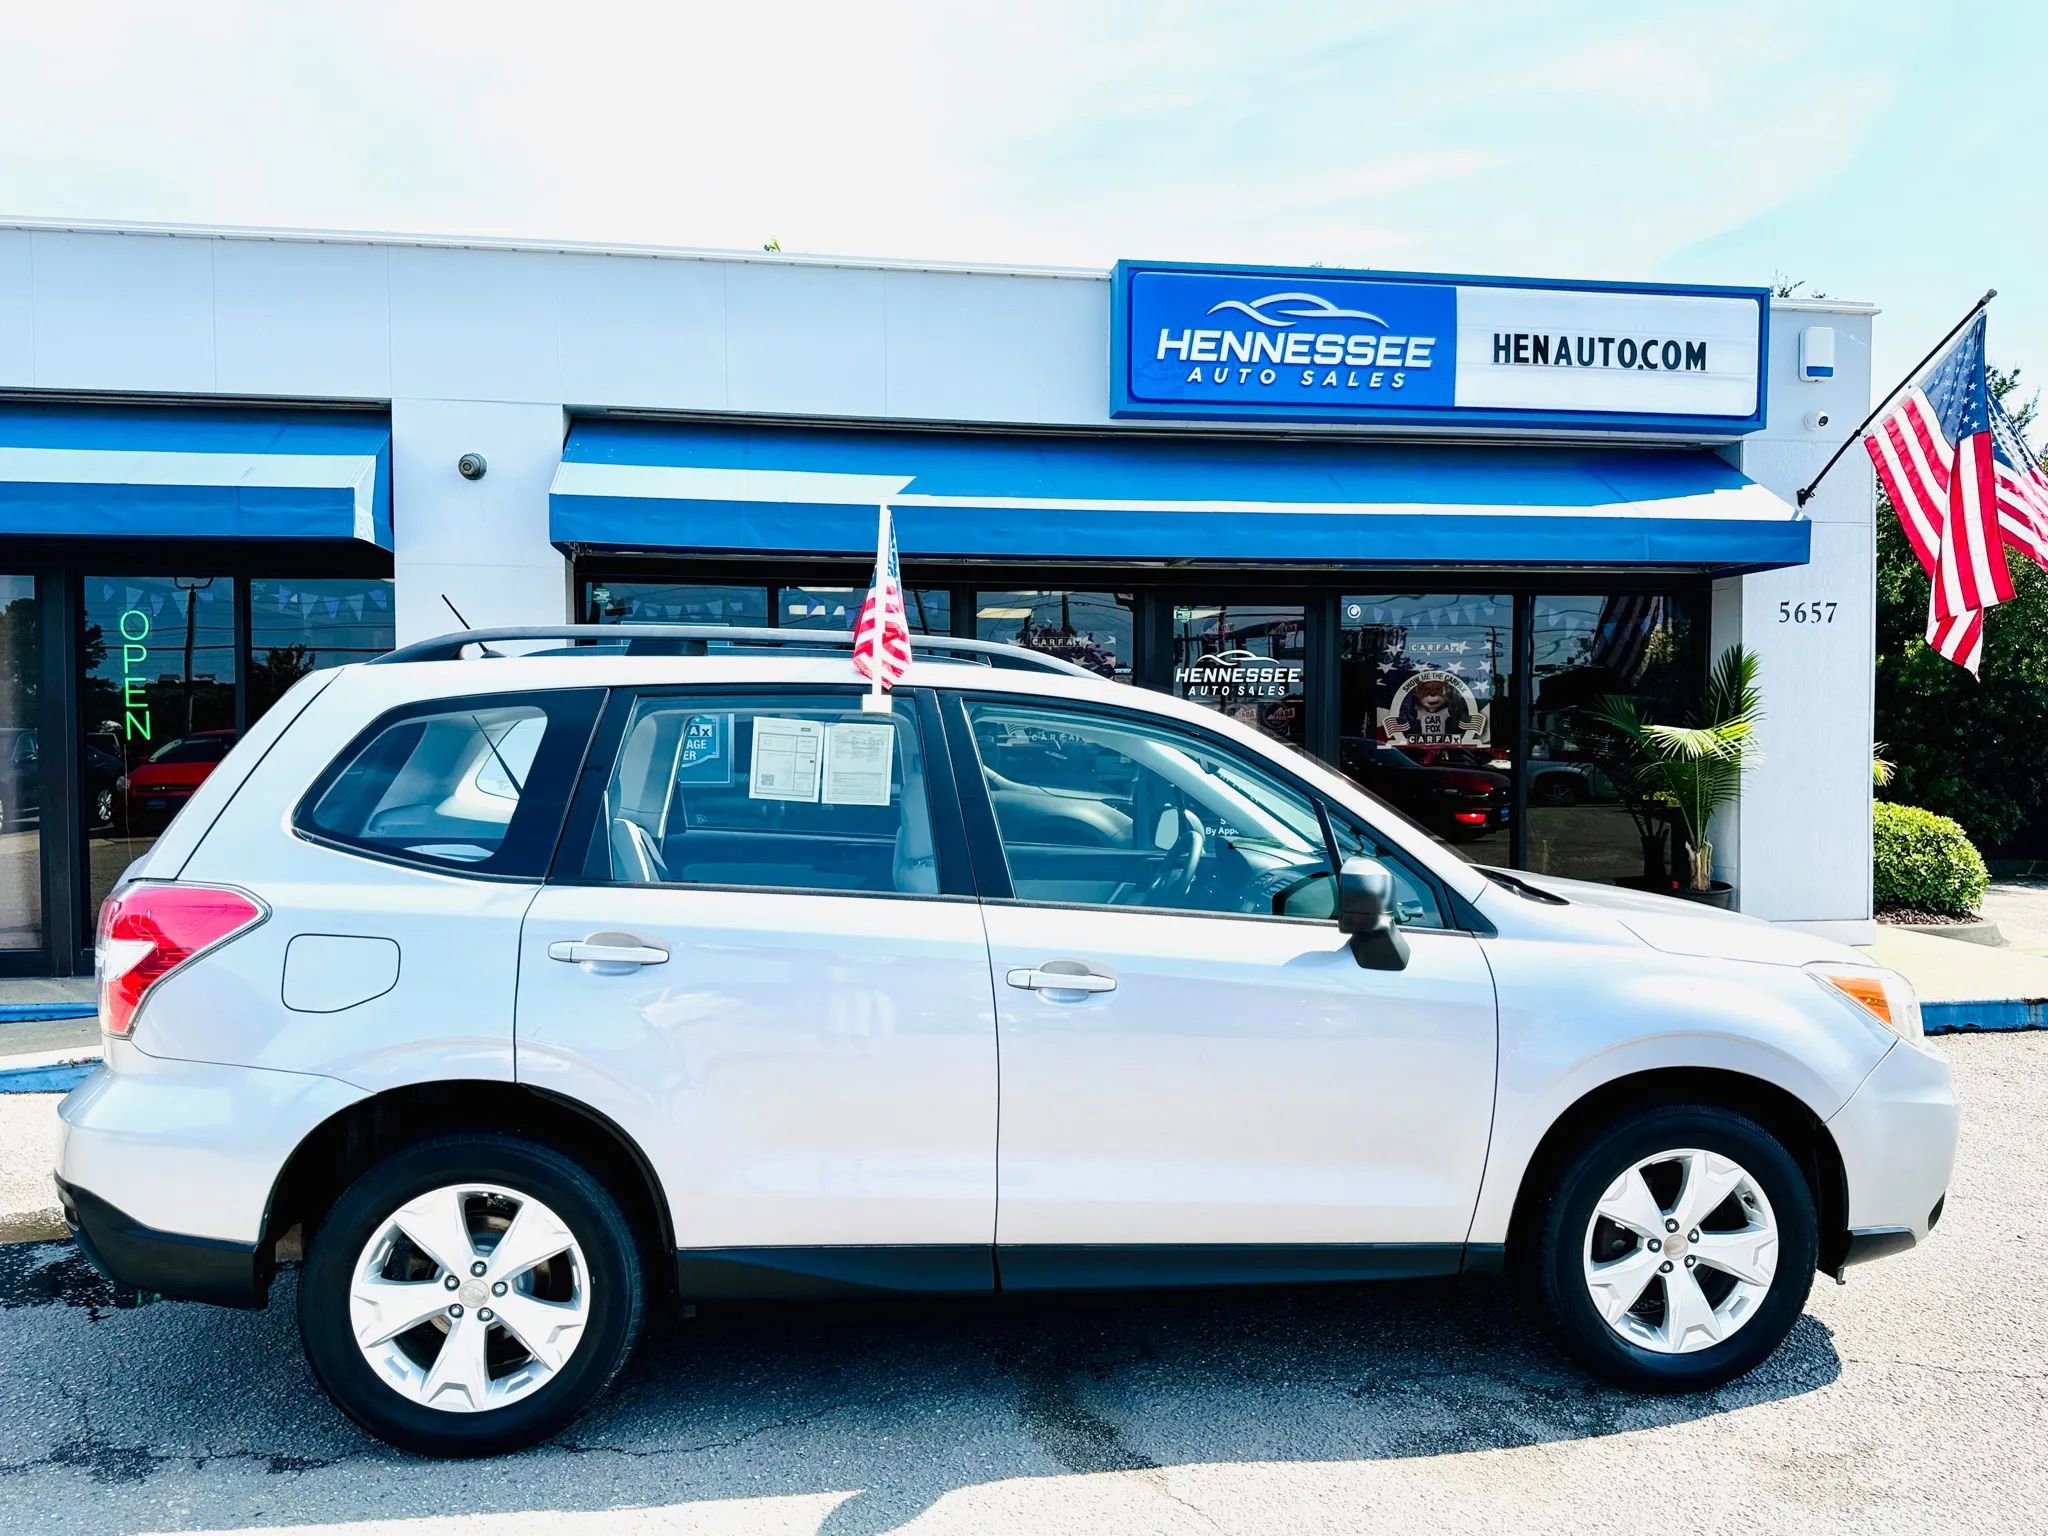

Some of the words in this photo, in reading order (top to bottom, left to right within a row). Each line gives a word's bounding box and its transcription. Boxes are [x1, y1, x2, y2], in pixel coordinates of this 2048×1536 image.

[1156, 328, 1436, 368] HENNESSEE
[1493, 333, 1707, 371] HENAUTO.COM
[1187, 366, 1276, 385] AUTO
[1300, 370, 1406, 388] SALES
[1779, 600, 1838, 624] 5657
[1031, 637, 1081, 647] CARFAX
[1410, 643, 1459, 652] CARFAX
[120, 609, 151, 741] OPEN
[1175, 667, 1302, 683] HENNESSEE
[1402, 676, 1421, 692] SHOW
[1420, 673, 1431, 681] ME
[1431, 672, 1445, 680] THE
[1444, 674, 1468, 694] CARFAX
[1188, 686, 1230, 695] AUTO
[1237, 686, 1285, 695] SALES
[1425, 716, 1441, 725] CAR
[1425, 725, 1441, 733] FOX
[1409, 735, 1460, 744] CARFAX
[1205, 827, 1217, 836] By
